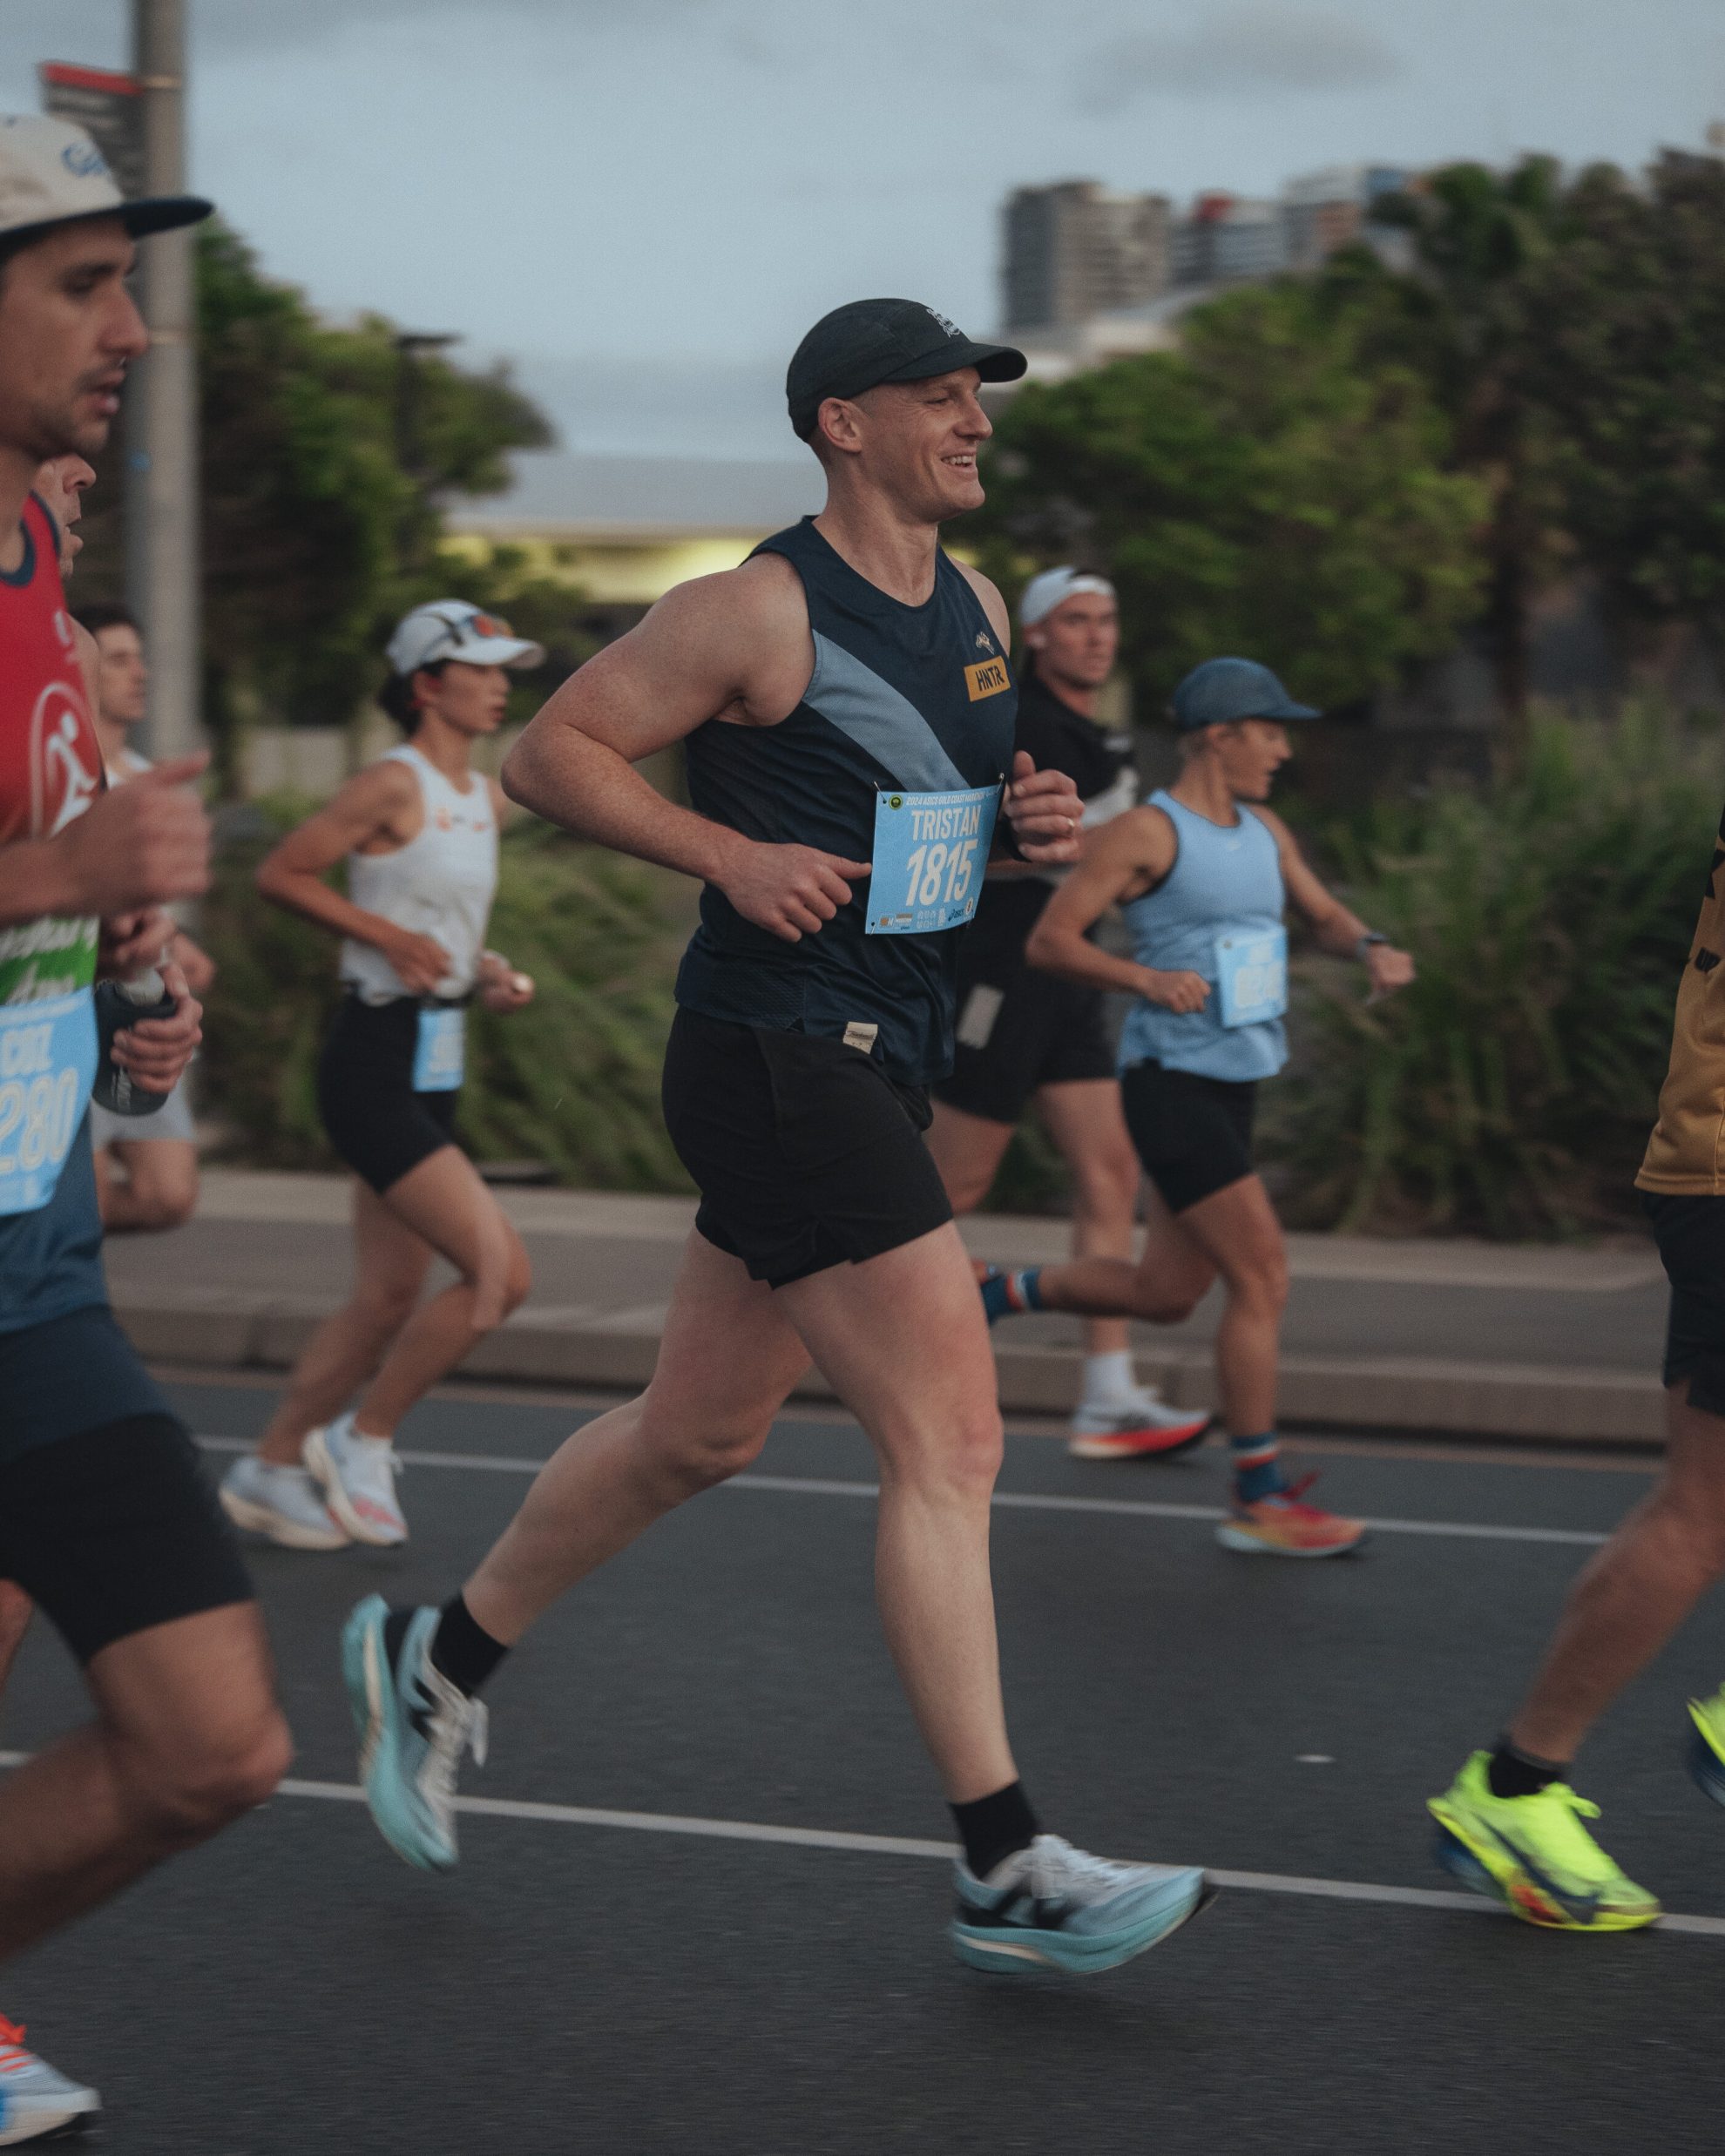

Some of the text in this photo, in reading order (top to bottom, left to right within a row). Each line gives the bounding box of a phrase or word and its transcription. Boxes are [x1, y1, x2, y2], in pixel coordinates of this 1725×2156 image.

[976, 666, 1005, 692] HNTR
[906, 796, 922, 806] 2024
[911, 805, 981, 841] TRISTAN
[906, 839, 978, 906] 1815
